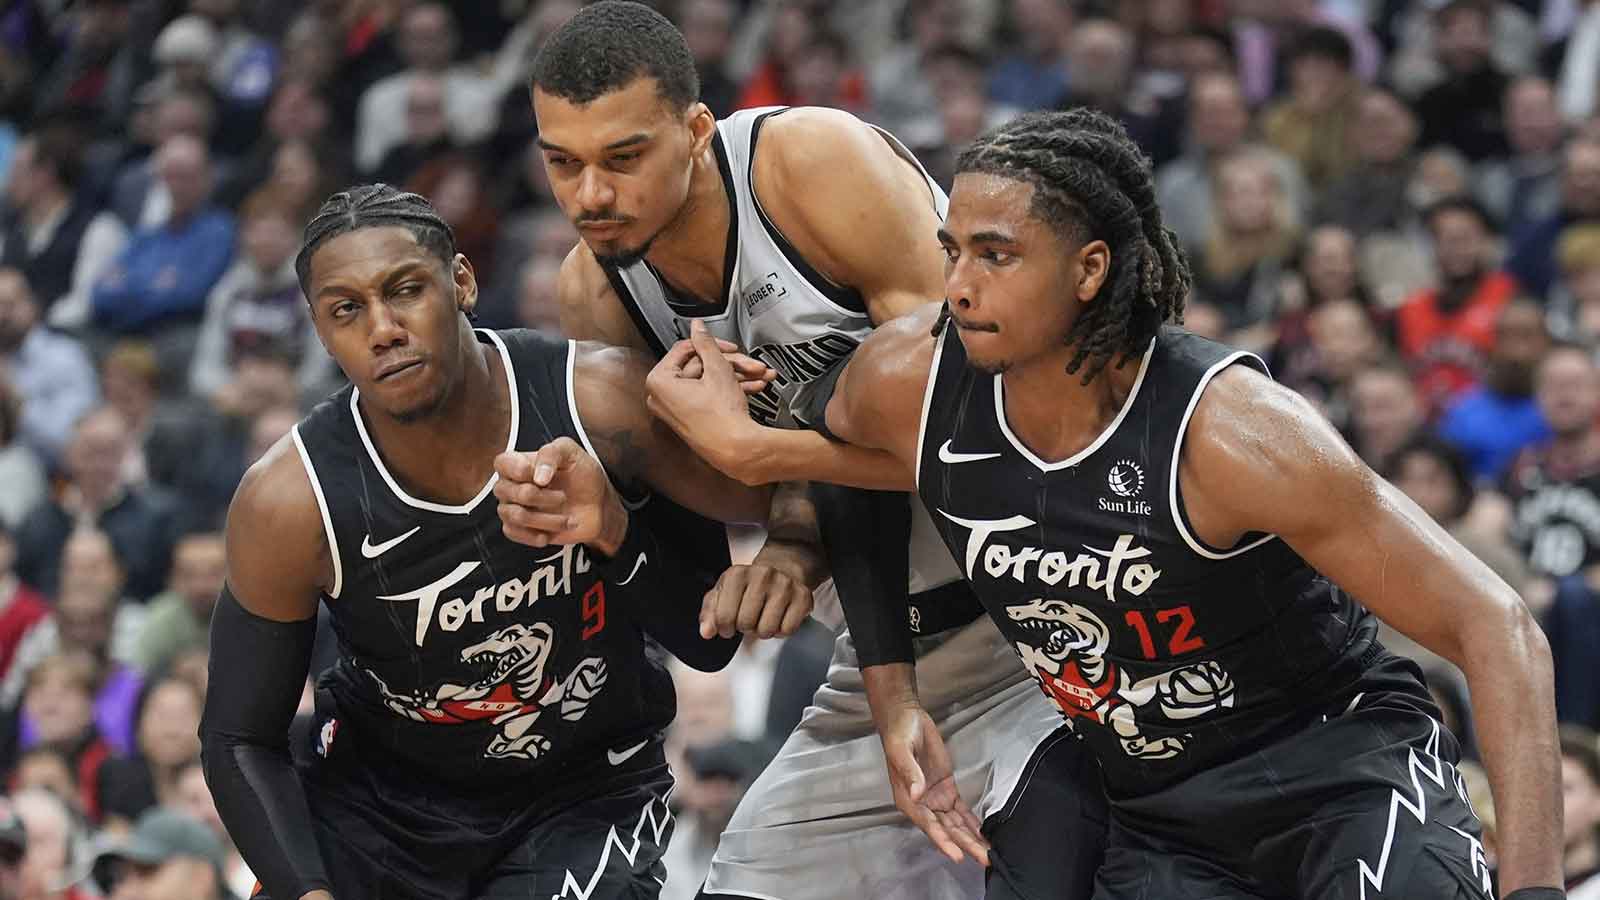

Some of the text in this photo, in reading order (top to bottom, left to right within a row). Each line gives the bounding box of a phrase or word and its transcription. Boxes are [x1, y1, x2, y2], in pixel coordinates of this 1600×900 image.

[1098, 498, 1151, 516] Sun Life
[937, 508, 1162, 602] Toronto
[581, 580, 606, 640] 9
[1125, 603, 1205, 658] 12
